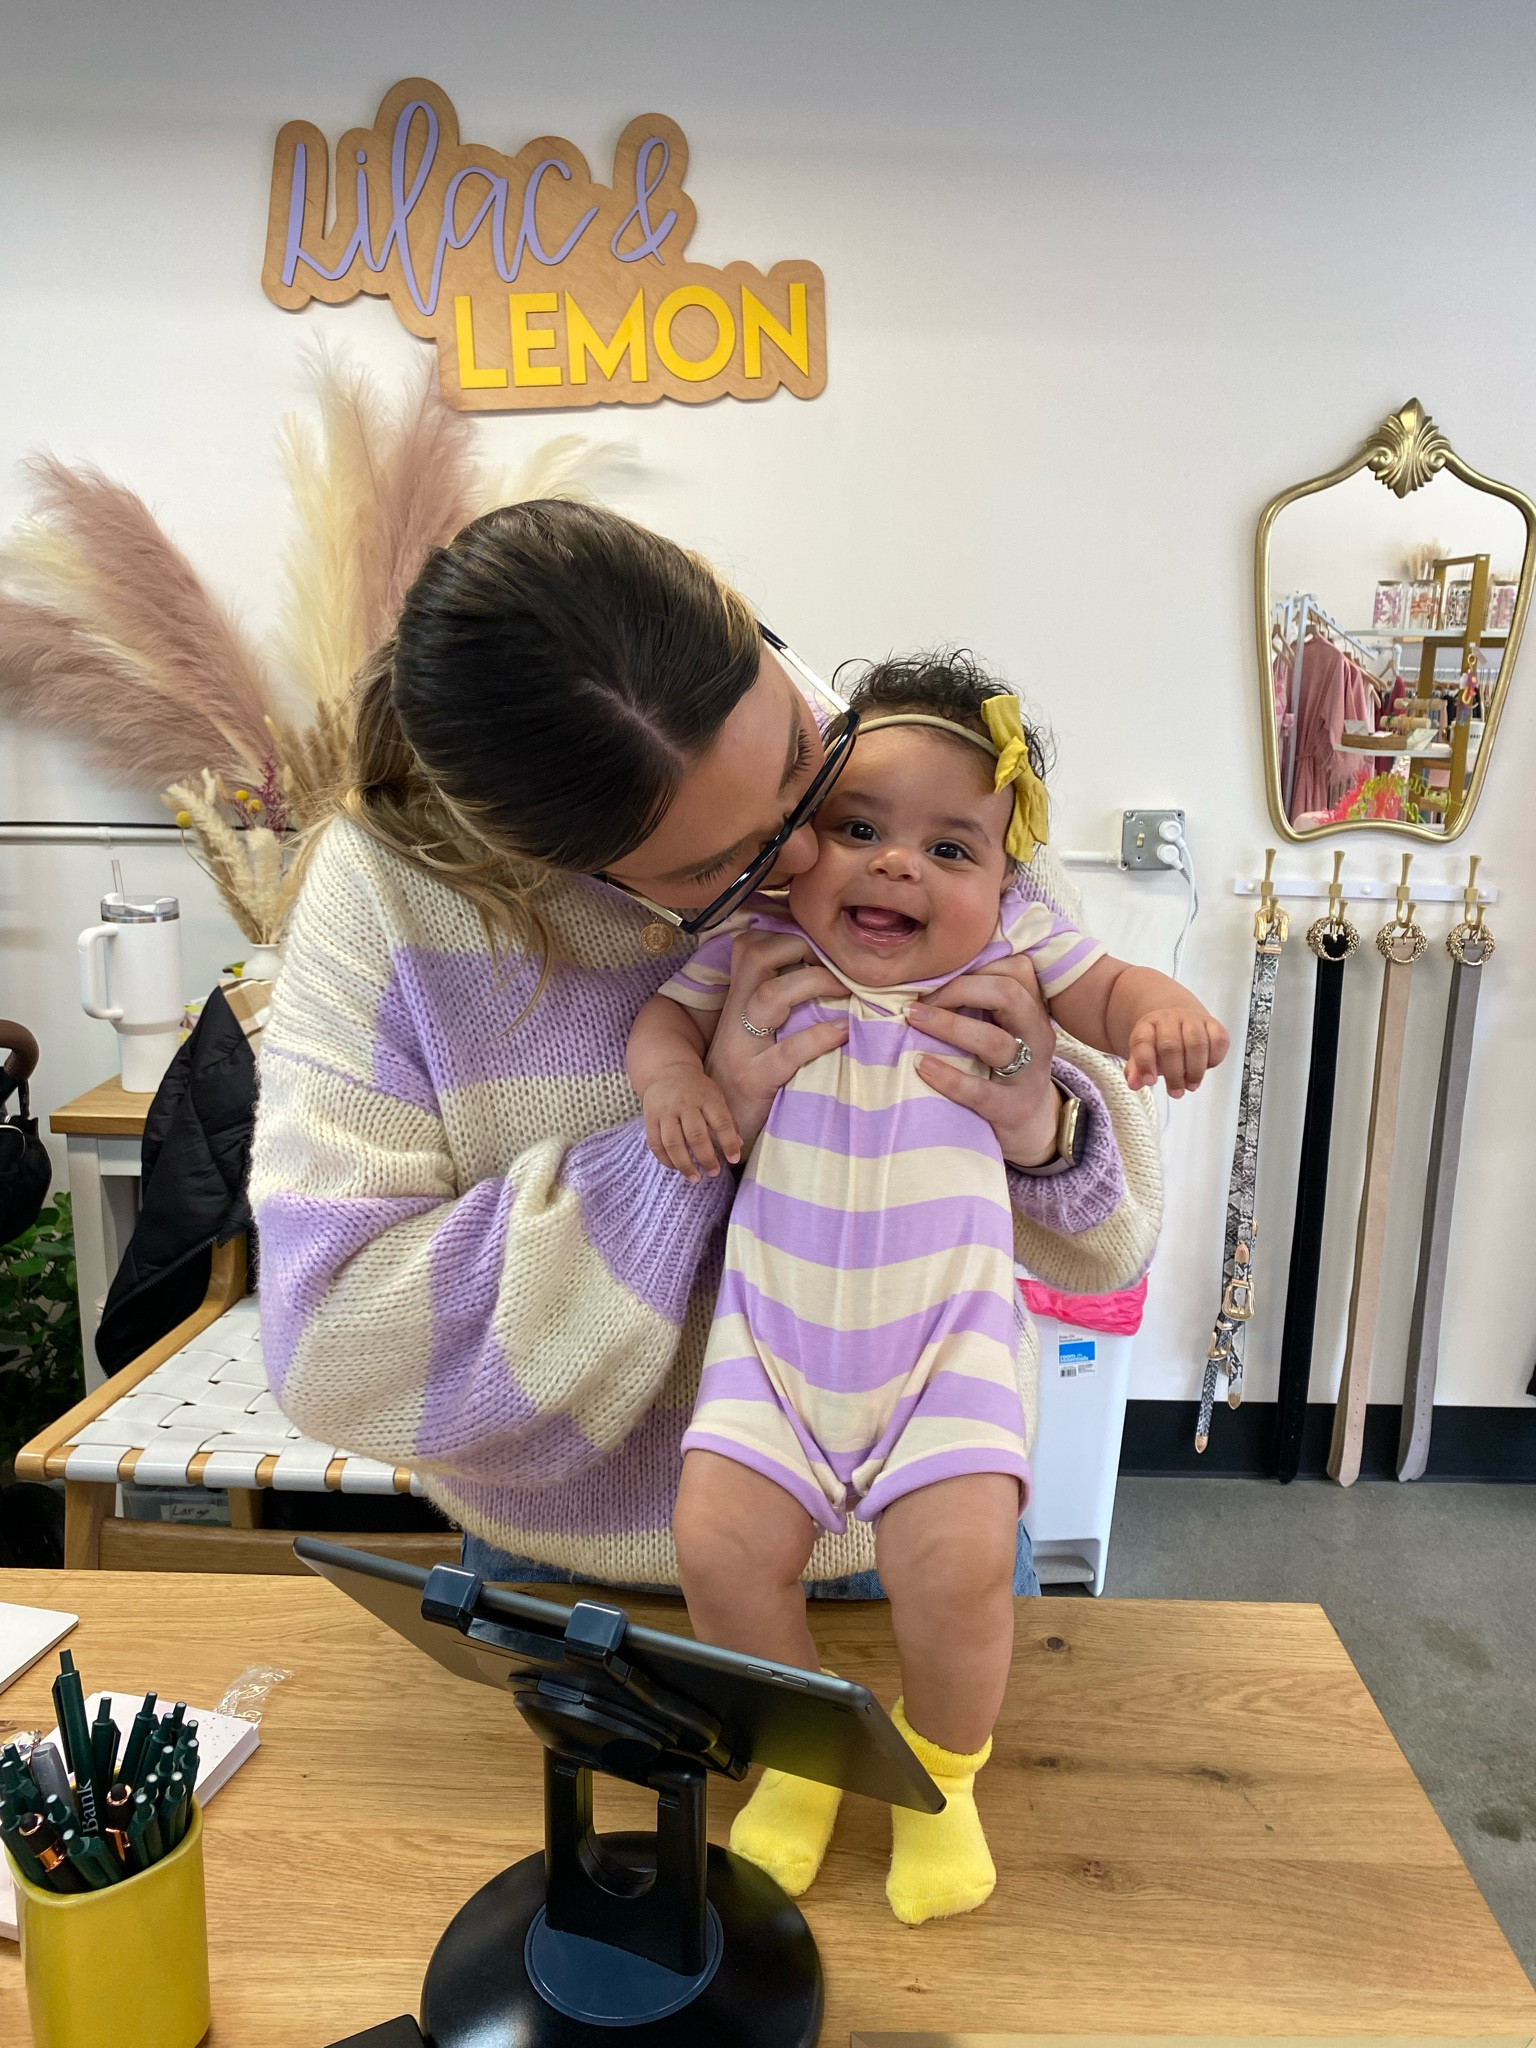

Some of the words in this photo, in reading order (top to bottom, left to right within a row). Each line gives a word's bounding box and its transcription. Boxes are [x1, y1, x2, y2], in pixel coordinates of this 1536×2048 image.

[281, 100, 600, 316] Lilac
[611, 136, 678, 265] &
[454, 282, 810, 390] LEMON
[77, 1778, 99, 1833] Bank
